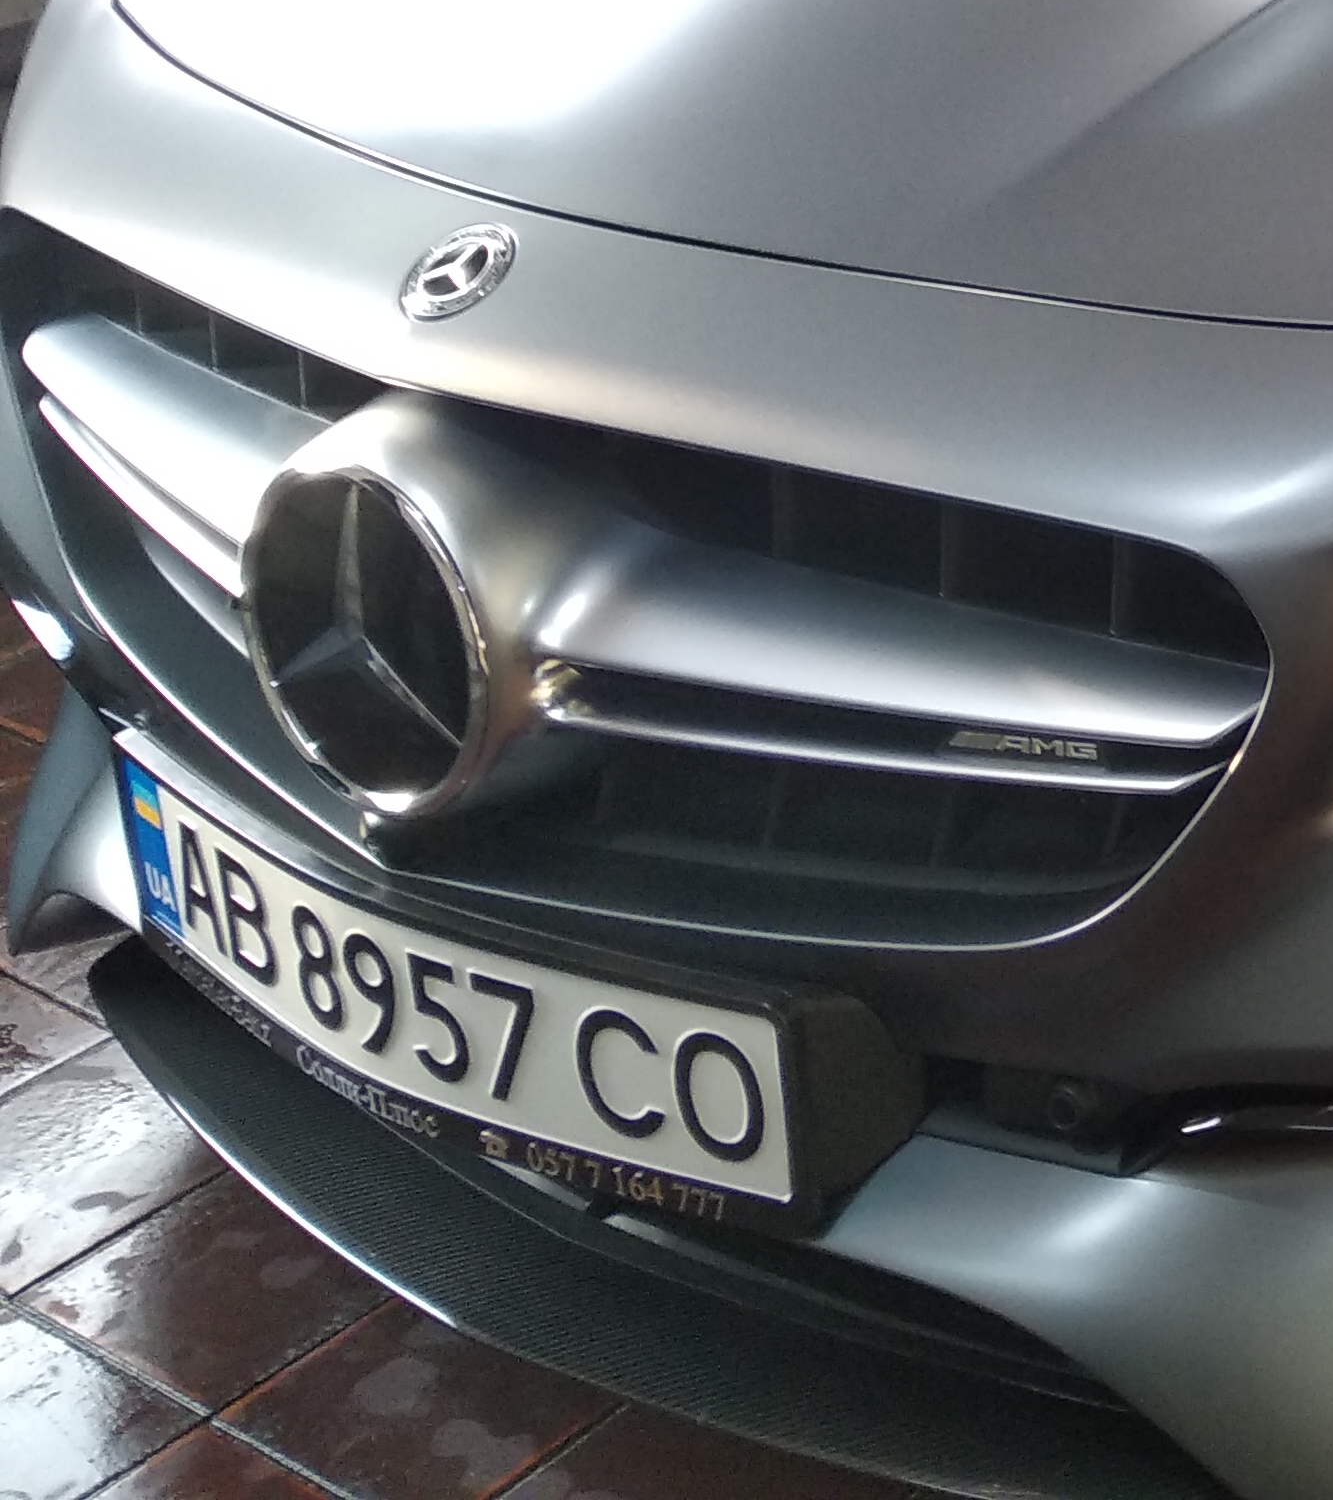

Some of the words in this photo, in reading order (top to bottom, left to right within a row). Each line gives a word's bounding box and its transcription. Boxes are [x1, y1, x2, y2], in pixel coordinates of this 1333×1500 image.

[998, 735, 1098, 761] AMG
[144, 861, 177, 912] UA
[178, 815, 279, 988] AB
[292, 905, 535, 1101] 8957
[576, 1008, 765, 1162] CO
[526, 1142, 577, 1182] 057
[584, 1159, 601, 1189] 7
[611, 1164, 664, 1206] 164
[671, 1182, 726, 1221] 777
